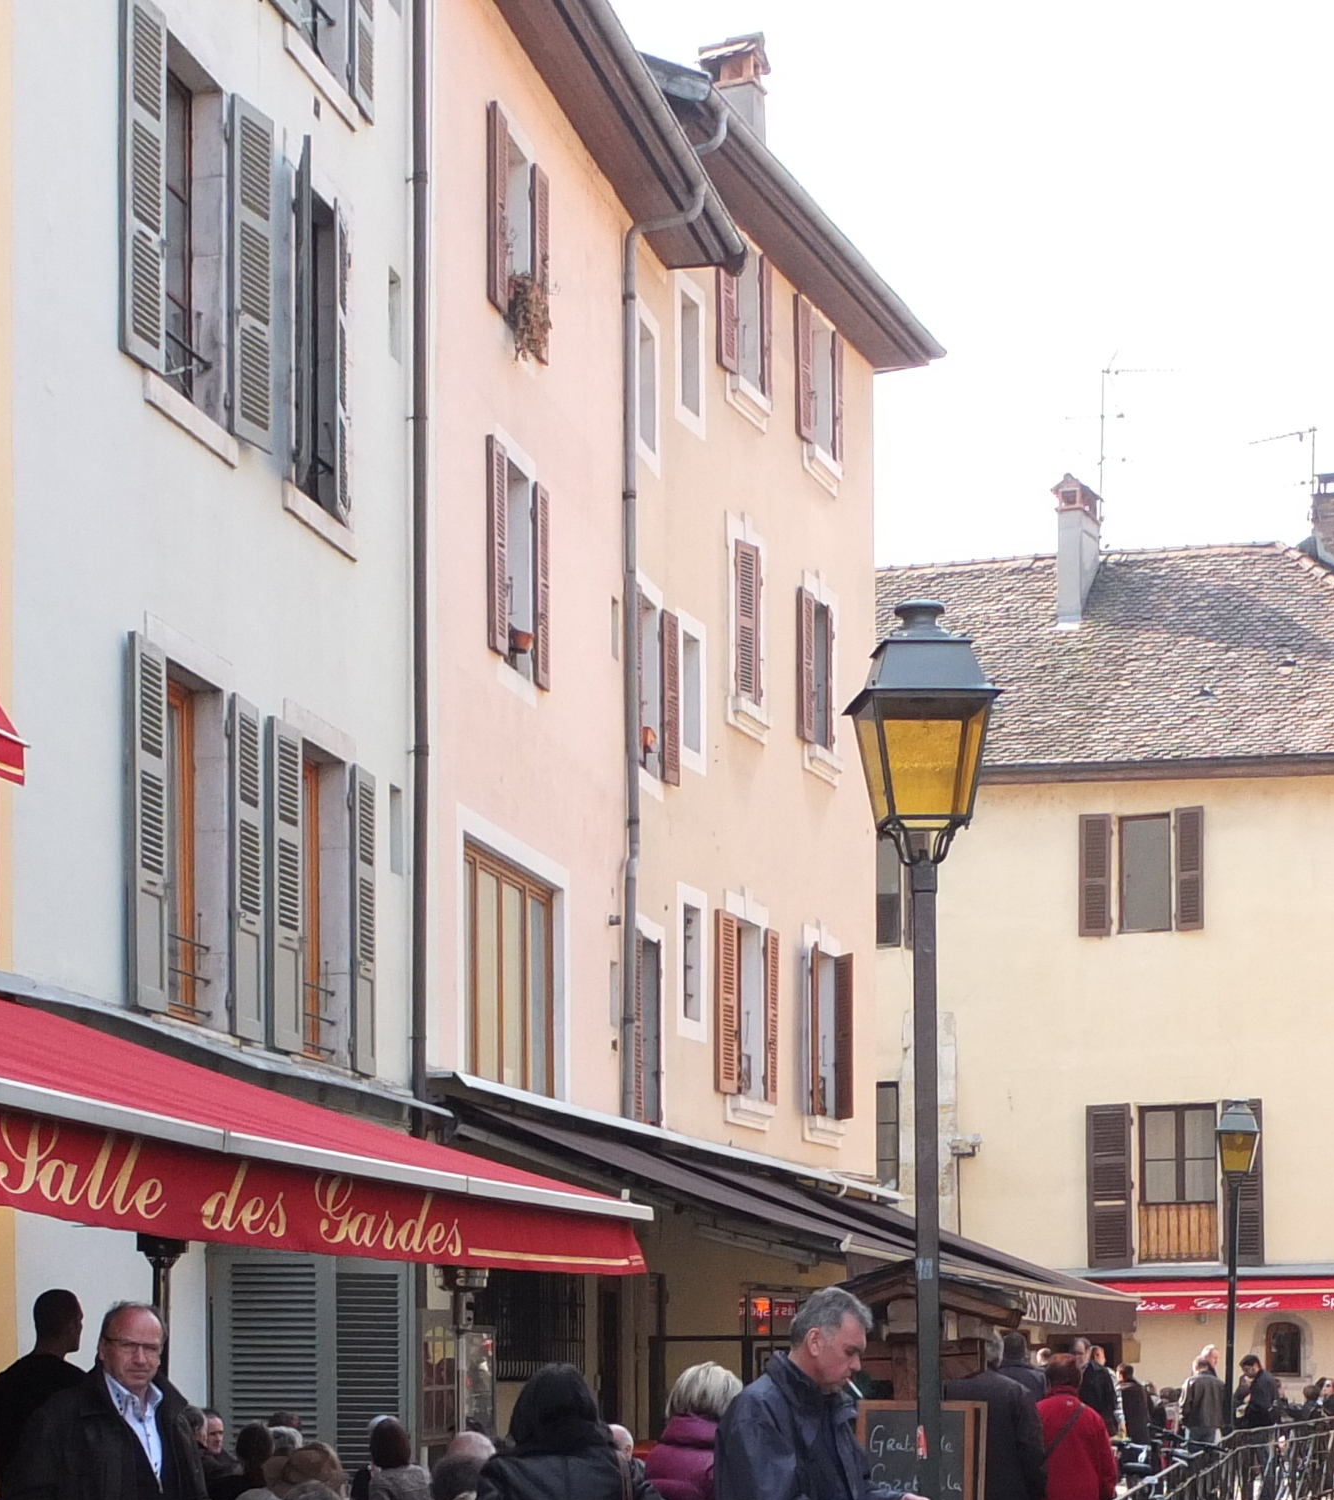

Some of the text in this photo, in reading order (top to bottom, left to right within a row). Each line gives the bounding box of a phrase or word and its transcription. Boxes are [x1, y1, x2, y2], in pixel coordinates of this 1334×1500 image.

[201, 1160, 287, 1238] des
[315, 1174, 463, 1258] Gardes
[1038, 1293, 1078, 1327] PRISONS
